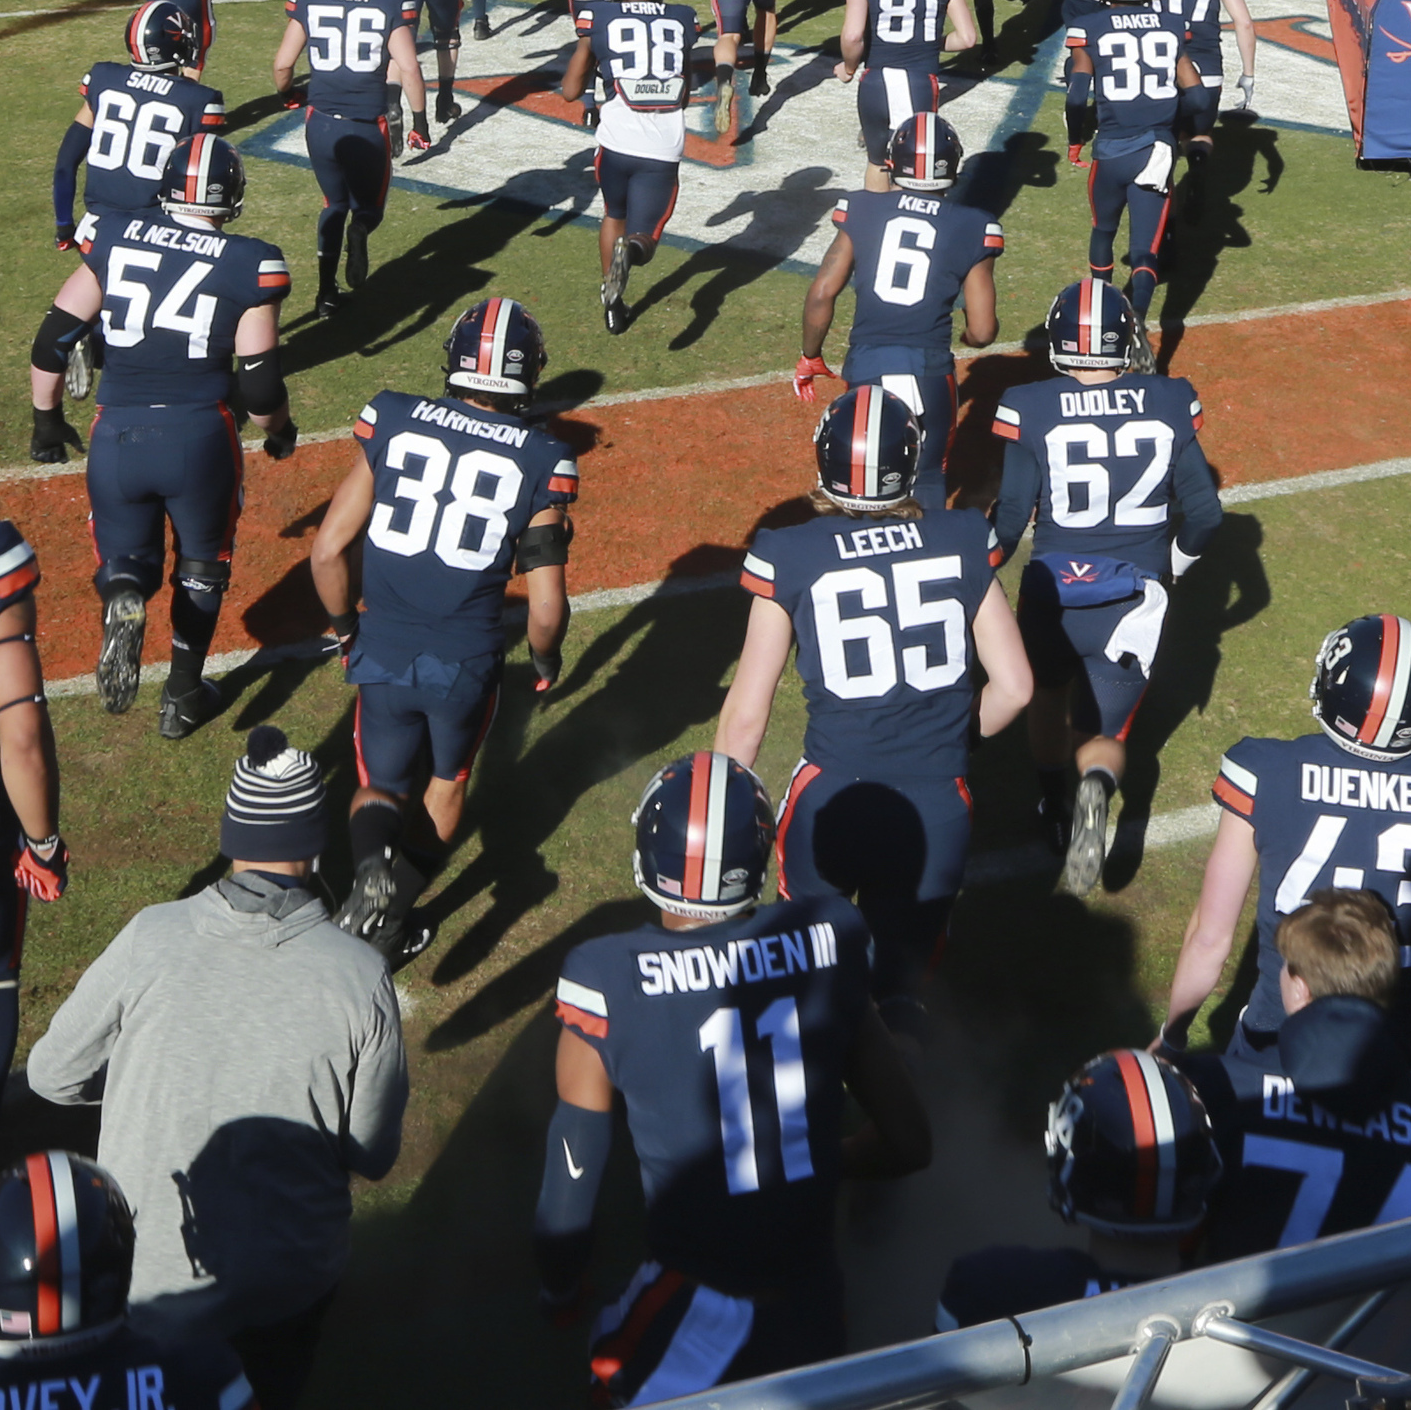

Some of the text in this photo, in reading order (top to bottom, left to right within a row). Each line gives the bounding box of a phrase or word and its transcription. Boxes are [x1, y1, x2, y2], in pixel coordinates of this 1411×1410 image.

[621, 2, 666, 16] PERRY
[1111, 13, 1161, 30] BAKER
[307, 5, 386, 72] 56
[607, 18, 685, 80] 98
[1098, 32, 1179, 102] 39
[634, 84, 671, 94] DOUGLAS
[87, 89, 184, 181] 66
[178, 205, 215, 215] VIRGINIA
[897, 194, 940, 216] KIER
[123, 220, 227, 258] R. NELSON
[873, 216, 937, 307] 6
[100, 245, 218, 359] 54
[467, 375, 509, 390] VIRGINIA
[1068, 356, 1110, 367] VIRGINIA
[411, 400, 528, 449] HARRISON
[1060, 389, 1146, 418] DUDLEY
[1044, 420, 1175, 529] 62
[367, 431, 524, 571] 38
[833, 522, 924, 559] LEECH
[809, 555, 968, 700] 65
[1339, 742, 1395, 762] VIRGINIA
[663, 902, 730, 921] VIRGINIA
[637, 922, 837, 997] SNOWDEN III
[698, 996, 815, 1196] 11
